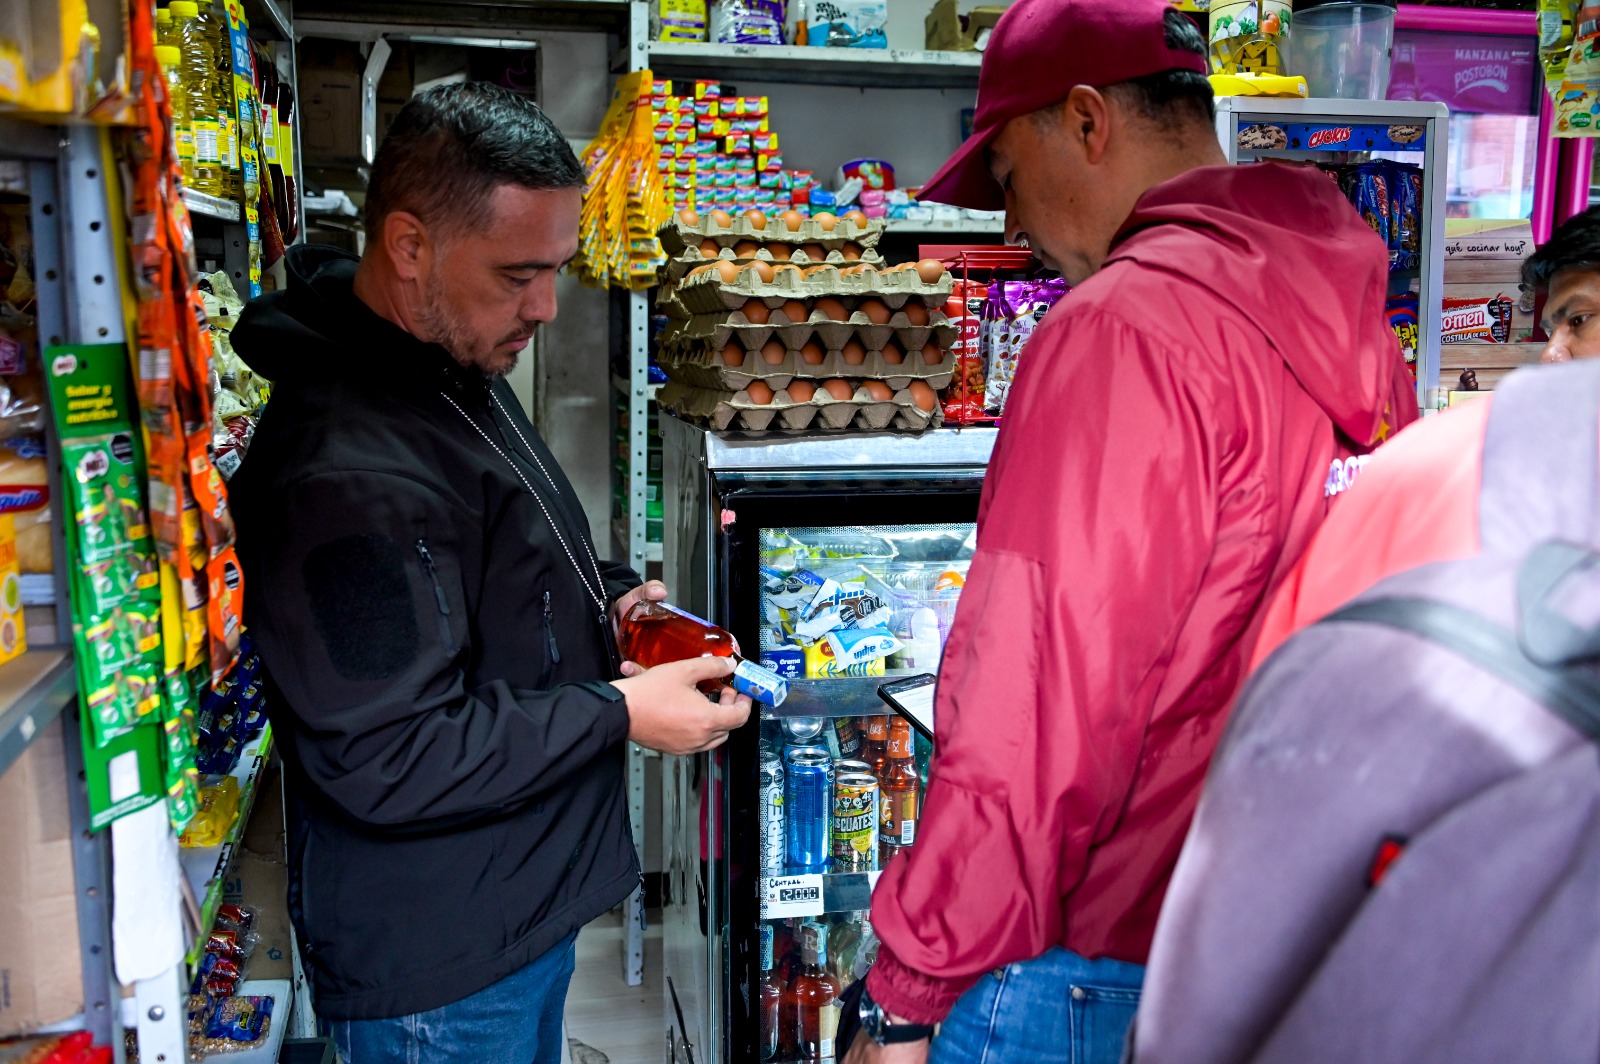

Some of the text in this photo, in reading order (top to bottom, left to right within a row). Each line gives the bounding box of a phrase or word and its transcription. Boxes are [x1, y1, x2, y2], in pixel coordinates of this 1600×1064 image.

[1455, 49, 1510, 60] MANZANA
[1455, 64, 1508, 90] POSTOBON
[1307, 126, 1351, 148] CHOKIS
[1445, 240, 1526, 256] qué cocinar hoy?
[1441, 333, 1472, 343] COSTILLA
[840, 811, 873, 832] CUATES
